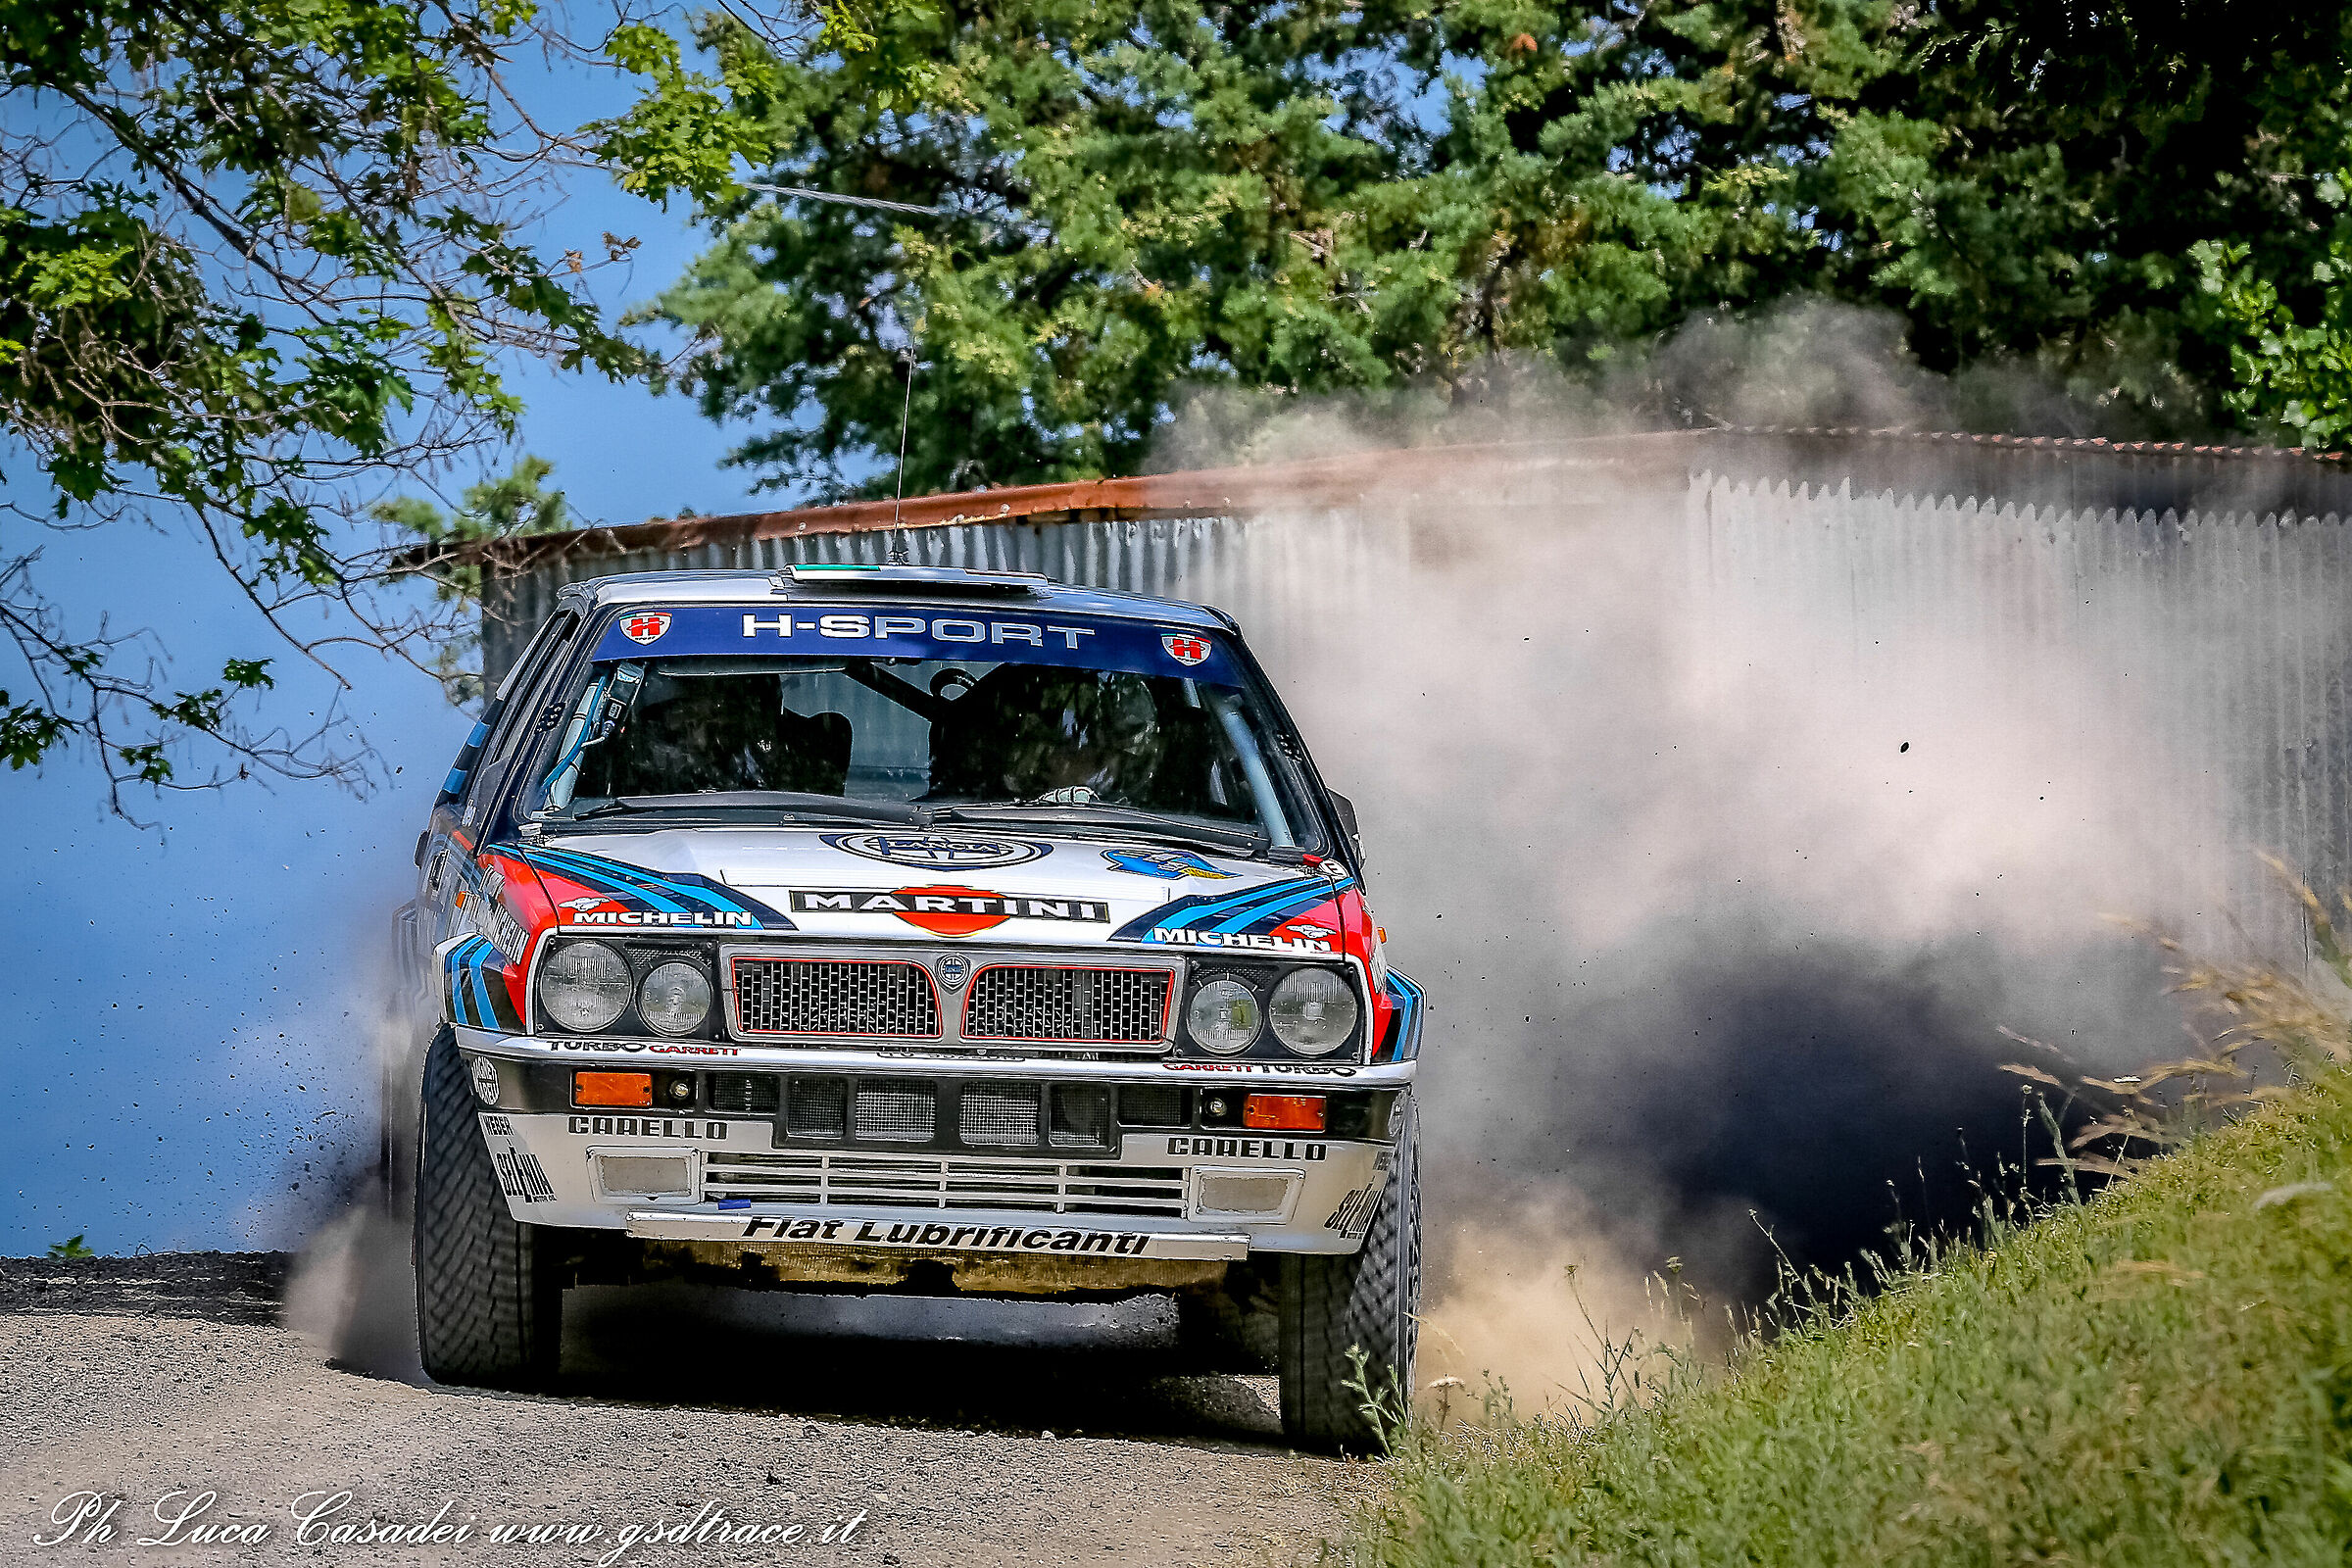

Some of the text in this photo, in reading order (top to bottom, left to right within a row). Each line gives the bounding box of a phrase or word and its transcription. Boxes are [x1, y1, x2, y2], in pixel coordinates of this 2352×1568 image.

[742, 613, 1096, 649] H-SPORT
[888, 839, 1000, 854] LANCIA
[572, 911, 754, 926] MICHELIN
[804, 893, 1098, 920] MARTINI
[1152, 927, 1333, 953] MICHELIN
[547, 1040, 740, 1056] TURBO GARRETT
[568, 1116, 728, 1140] CARELLO
[1167, 1137, 1327, 1161] CARELLO
[741, 1215, 1151, 1255] Fiat Lubrificanti
